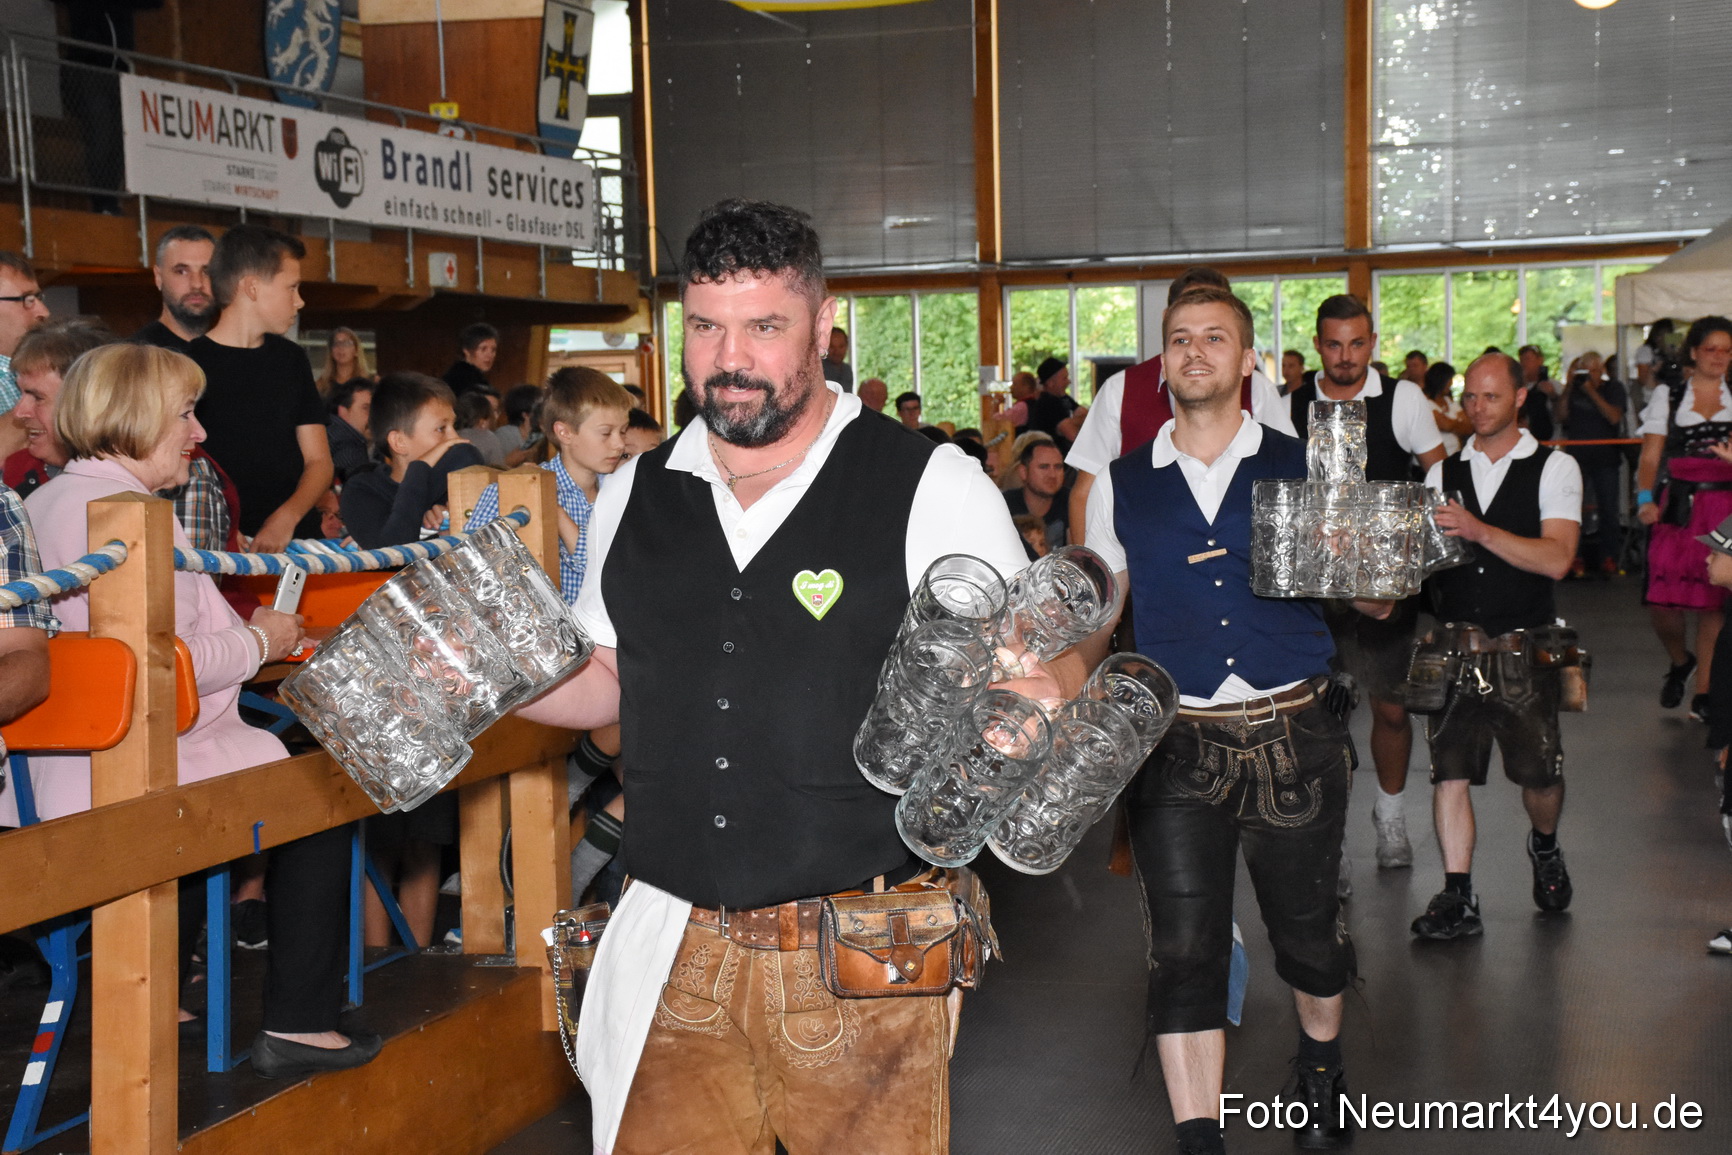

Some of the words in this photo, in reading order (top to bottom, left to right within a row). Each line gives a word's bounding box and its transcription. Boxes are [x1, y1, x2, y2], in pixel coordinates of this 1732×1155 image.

[141, 90, 275, 152] NEUMARKT
[318, 151, 359, 184] WiFi
[381, 138, 472, 192] Brandl
[487, 165, 584, 209] services
[384, 197, 438, 221] einfach
[443, 206, 491, 228] schnell
[506, 213, 563, 237] Glasfaser
[565, 221, 585, 240] DSL
